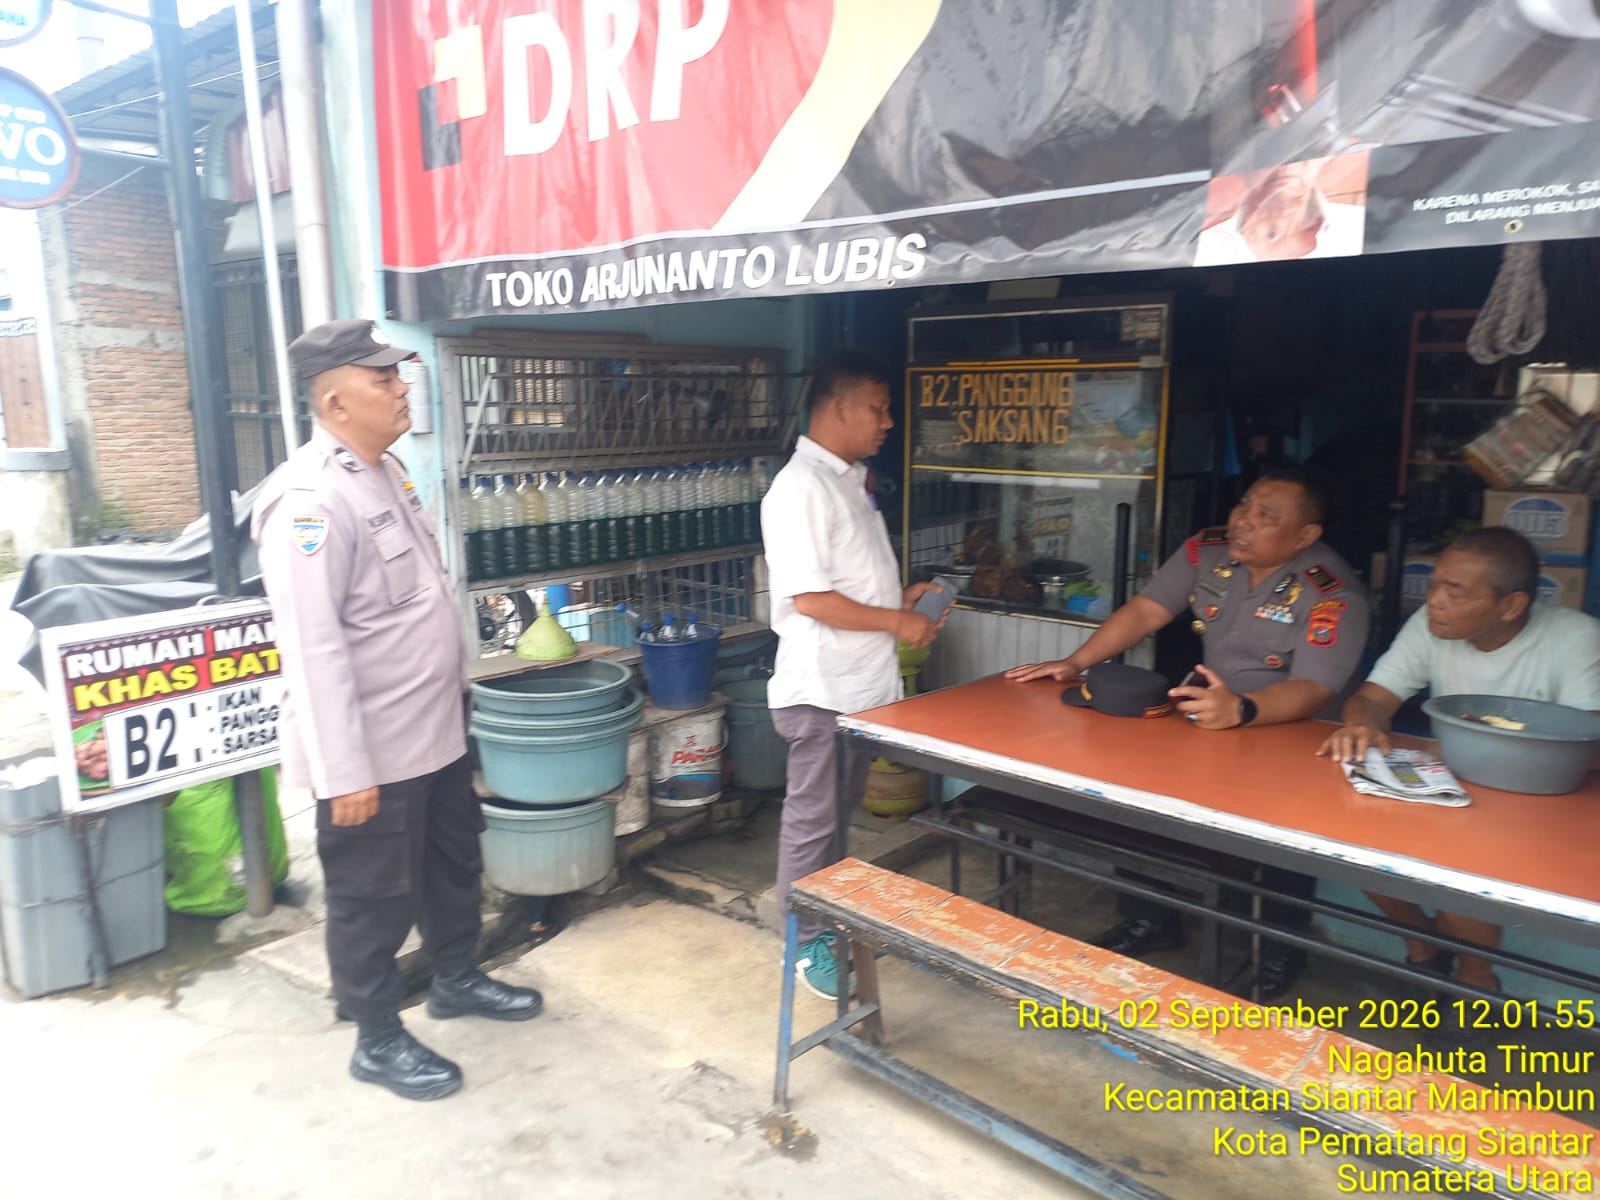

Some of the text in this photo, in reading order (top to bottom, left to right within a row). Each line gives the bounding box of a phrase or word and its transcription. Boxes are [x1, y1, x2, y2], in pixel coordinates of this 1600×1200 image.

[502, 0, 731, 157] DRP
[1413, 193, 1480, 211] KARENA
[1445, 204, 1531, 225] DILARANG
[485, 233, 928, 308] TOKO ARJUNANTO LUBIS
[66, 632, 205, 679] RUMAH
[73, 664, 199, 712] KHAS
[218, 687, 262, 713] IKAN
[124, 707, 178, 780] B2
